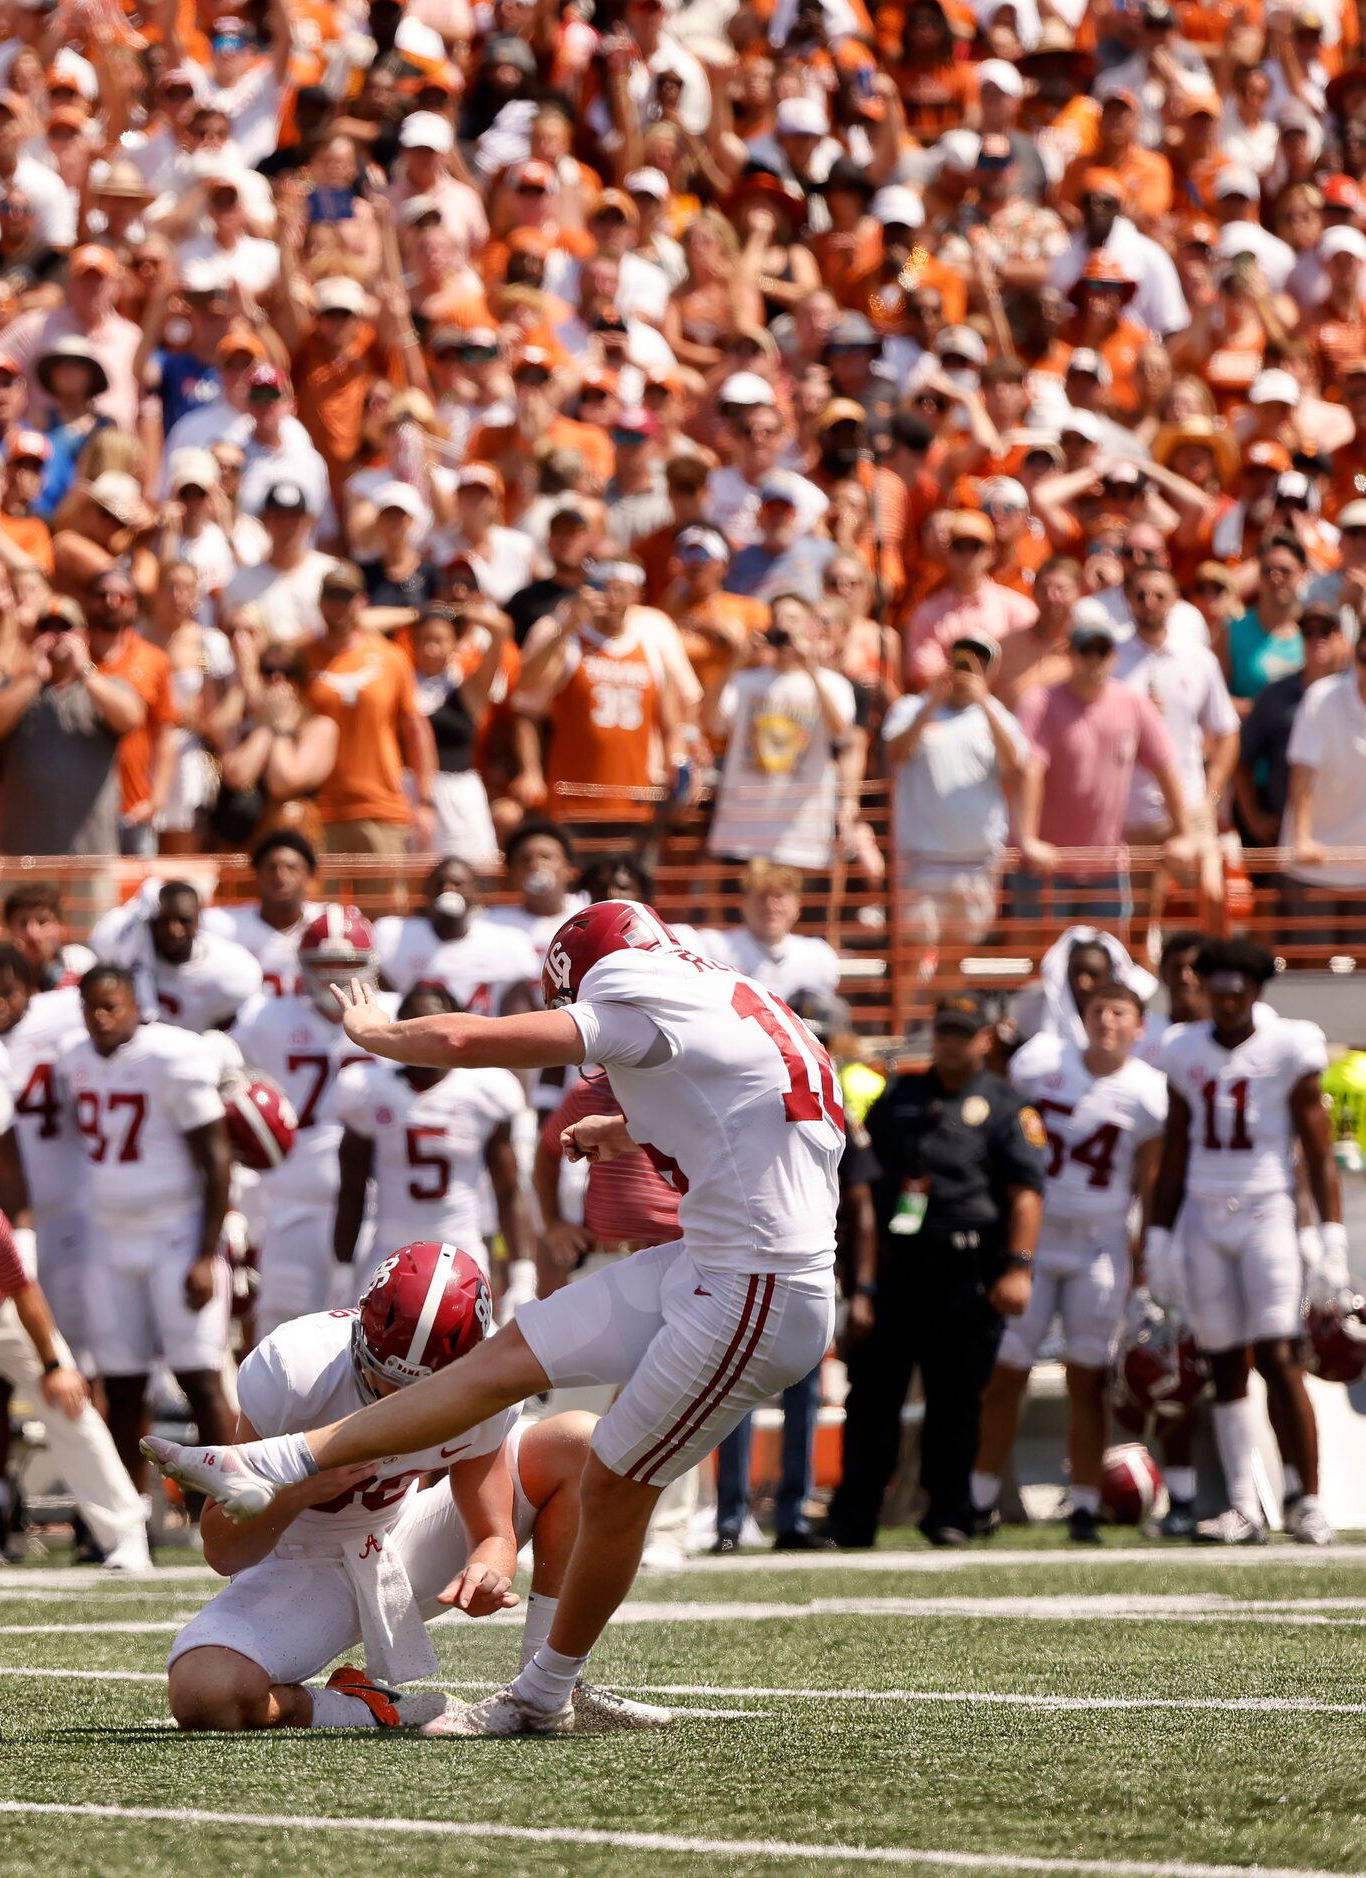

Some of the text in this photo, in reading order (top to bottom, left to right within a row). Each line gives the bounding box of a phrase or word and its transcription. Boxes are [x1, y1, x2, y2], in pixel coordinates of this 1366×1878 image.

[545, 941, 571, 989] 16
[77, 1092, 147, 1164] 97
[1035, 1098, 1122, 1187] 54
[1202, 1079, 1253, 1150] 11
[406, 1127, 451, 1201] 5
[202, 1452, 216, 1466] 16
